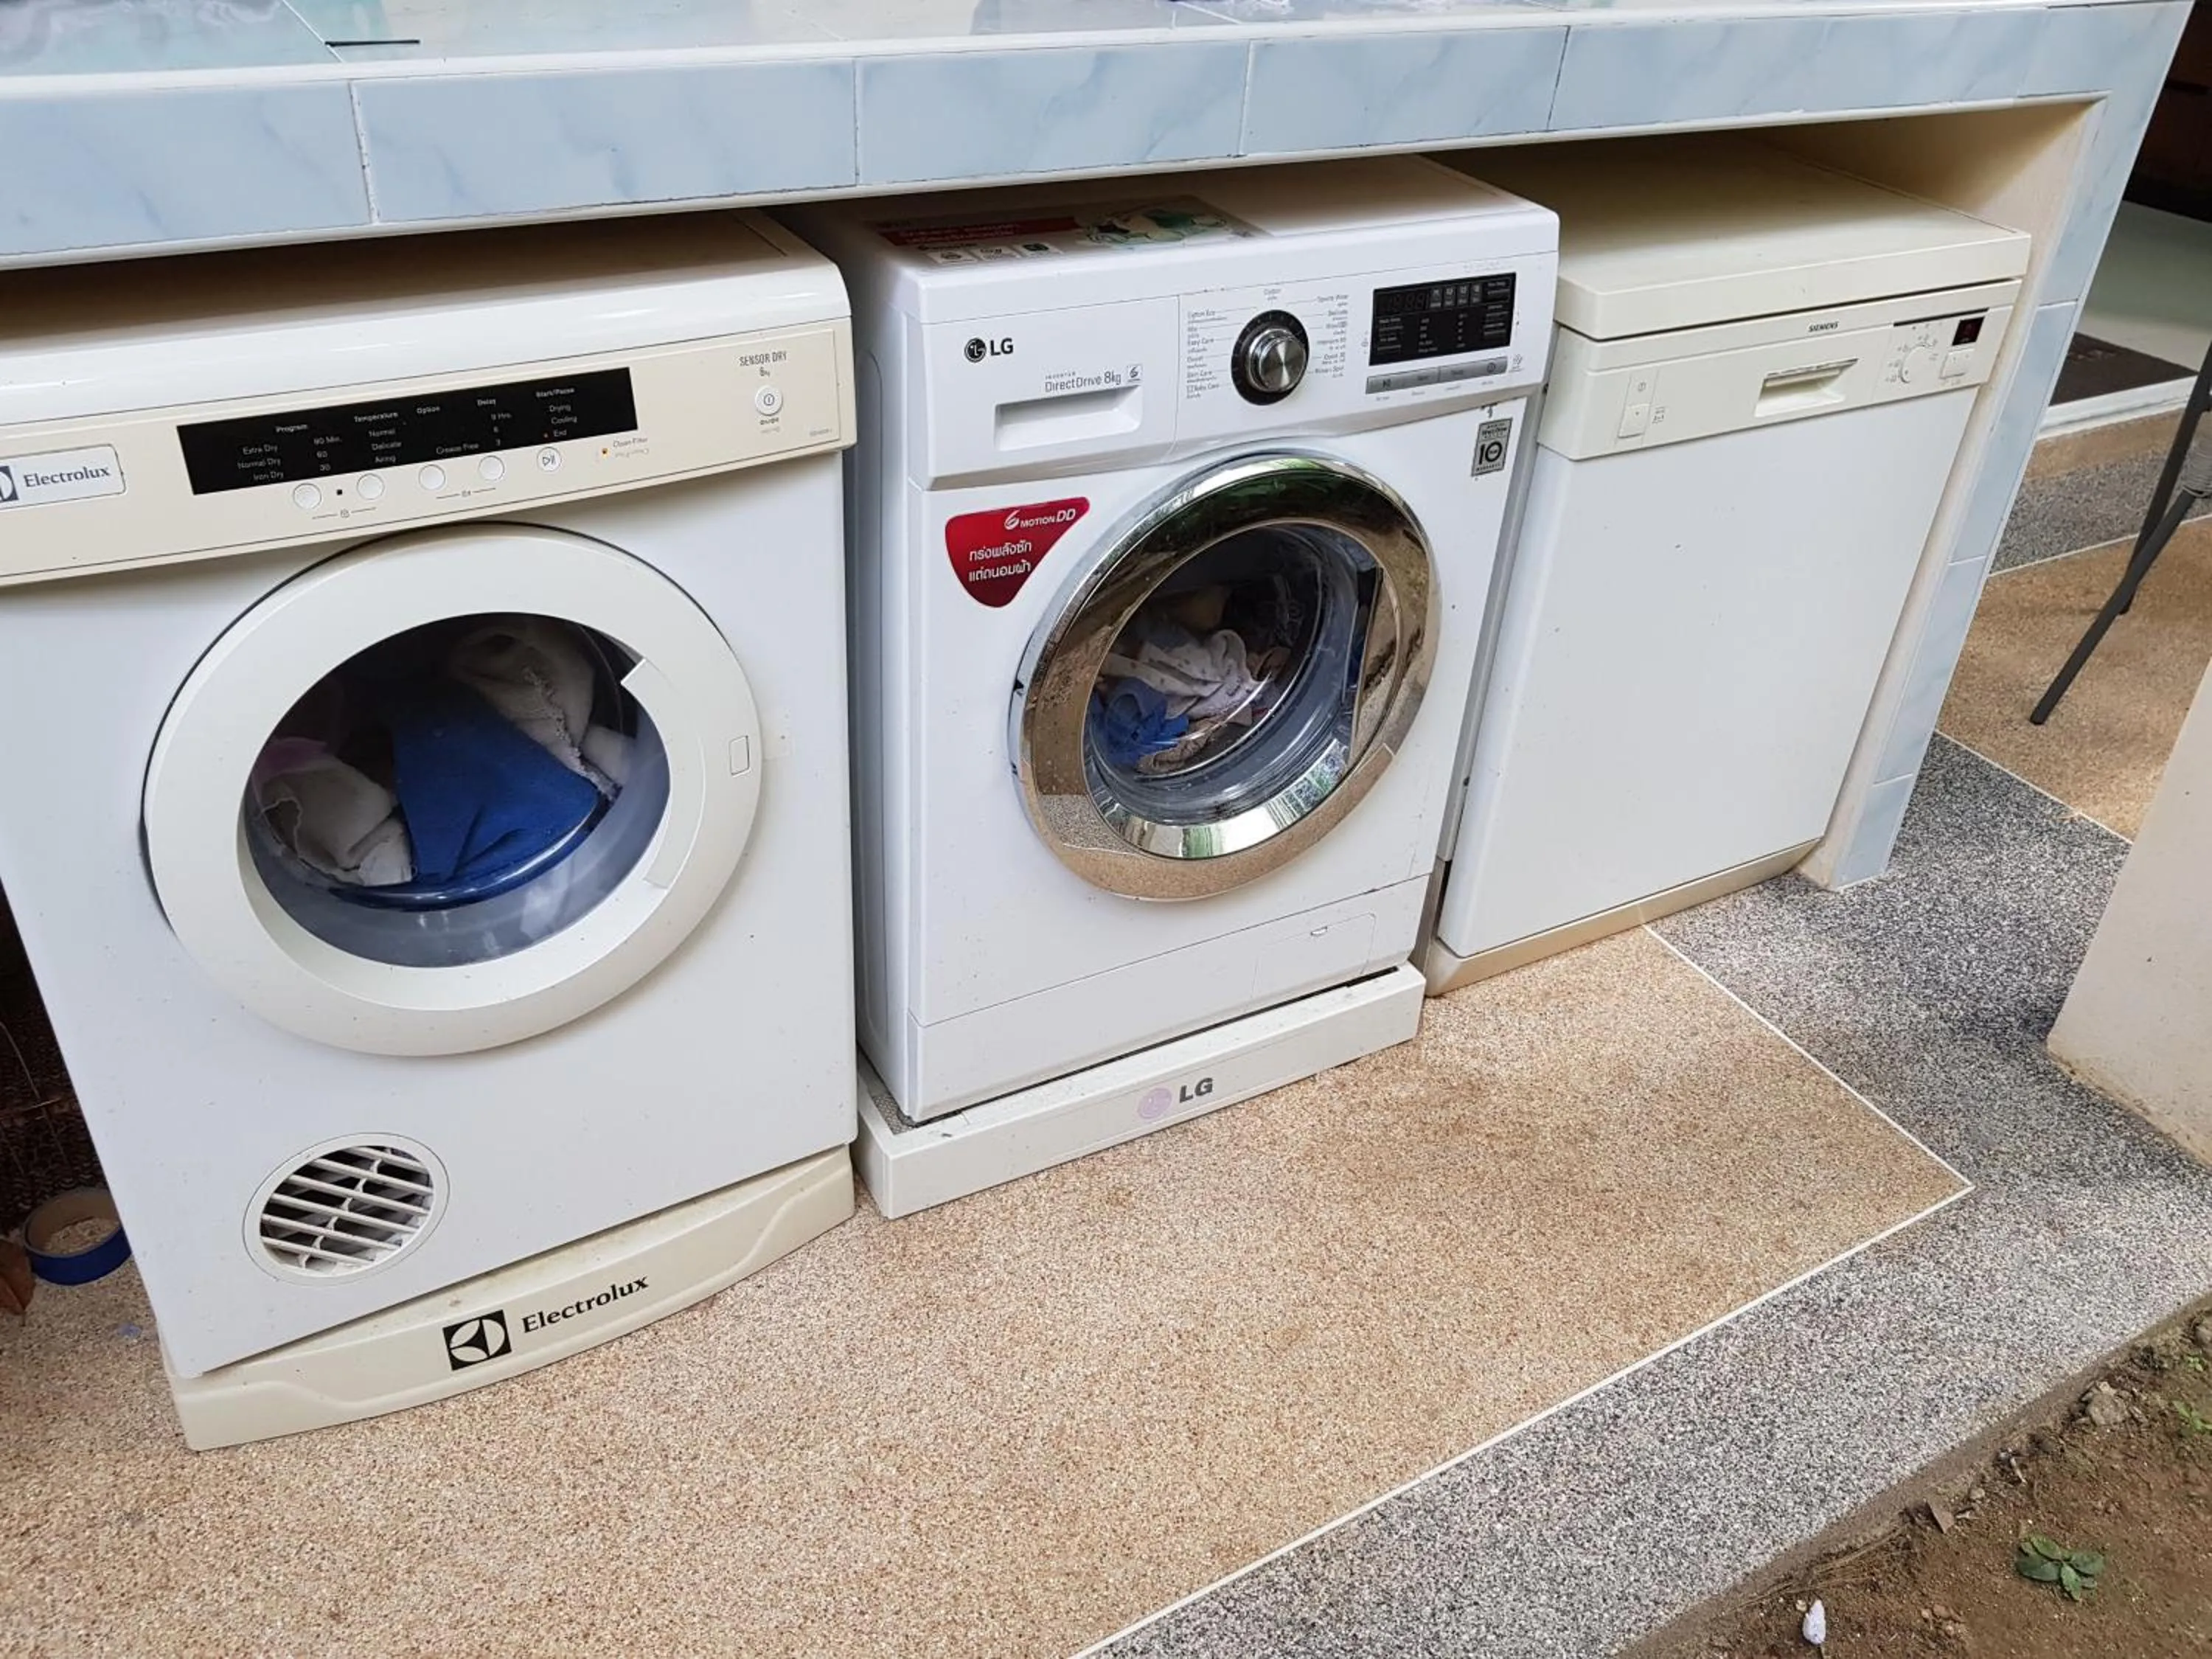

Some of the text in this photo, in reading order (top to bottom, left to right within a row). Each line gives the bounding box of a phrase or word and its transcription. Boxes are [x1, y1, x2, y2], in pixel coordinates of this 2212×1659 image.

[990, 338, 1014, 356] LG
[739, 350, 787, 367] SENSOR DRY
[1103, 371, 1121, 386] 8kg
[553, 428, 568, 437] End
[23, 465, 111, 488] Electrolux
[1020, 516, 1056, 529] MOTION
[1055, 508, 1077, 523] DD
[1179, 1077, 1214, 1104] LG
[521, 1276, 649, 1333] Electrolux
